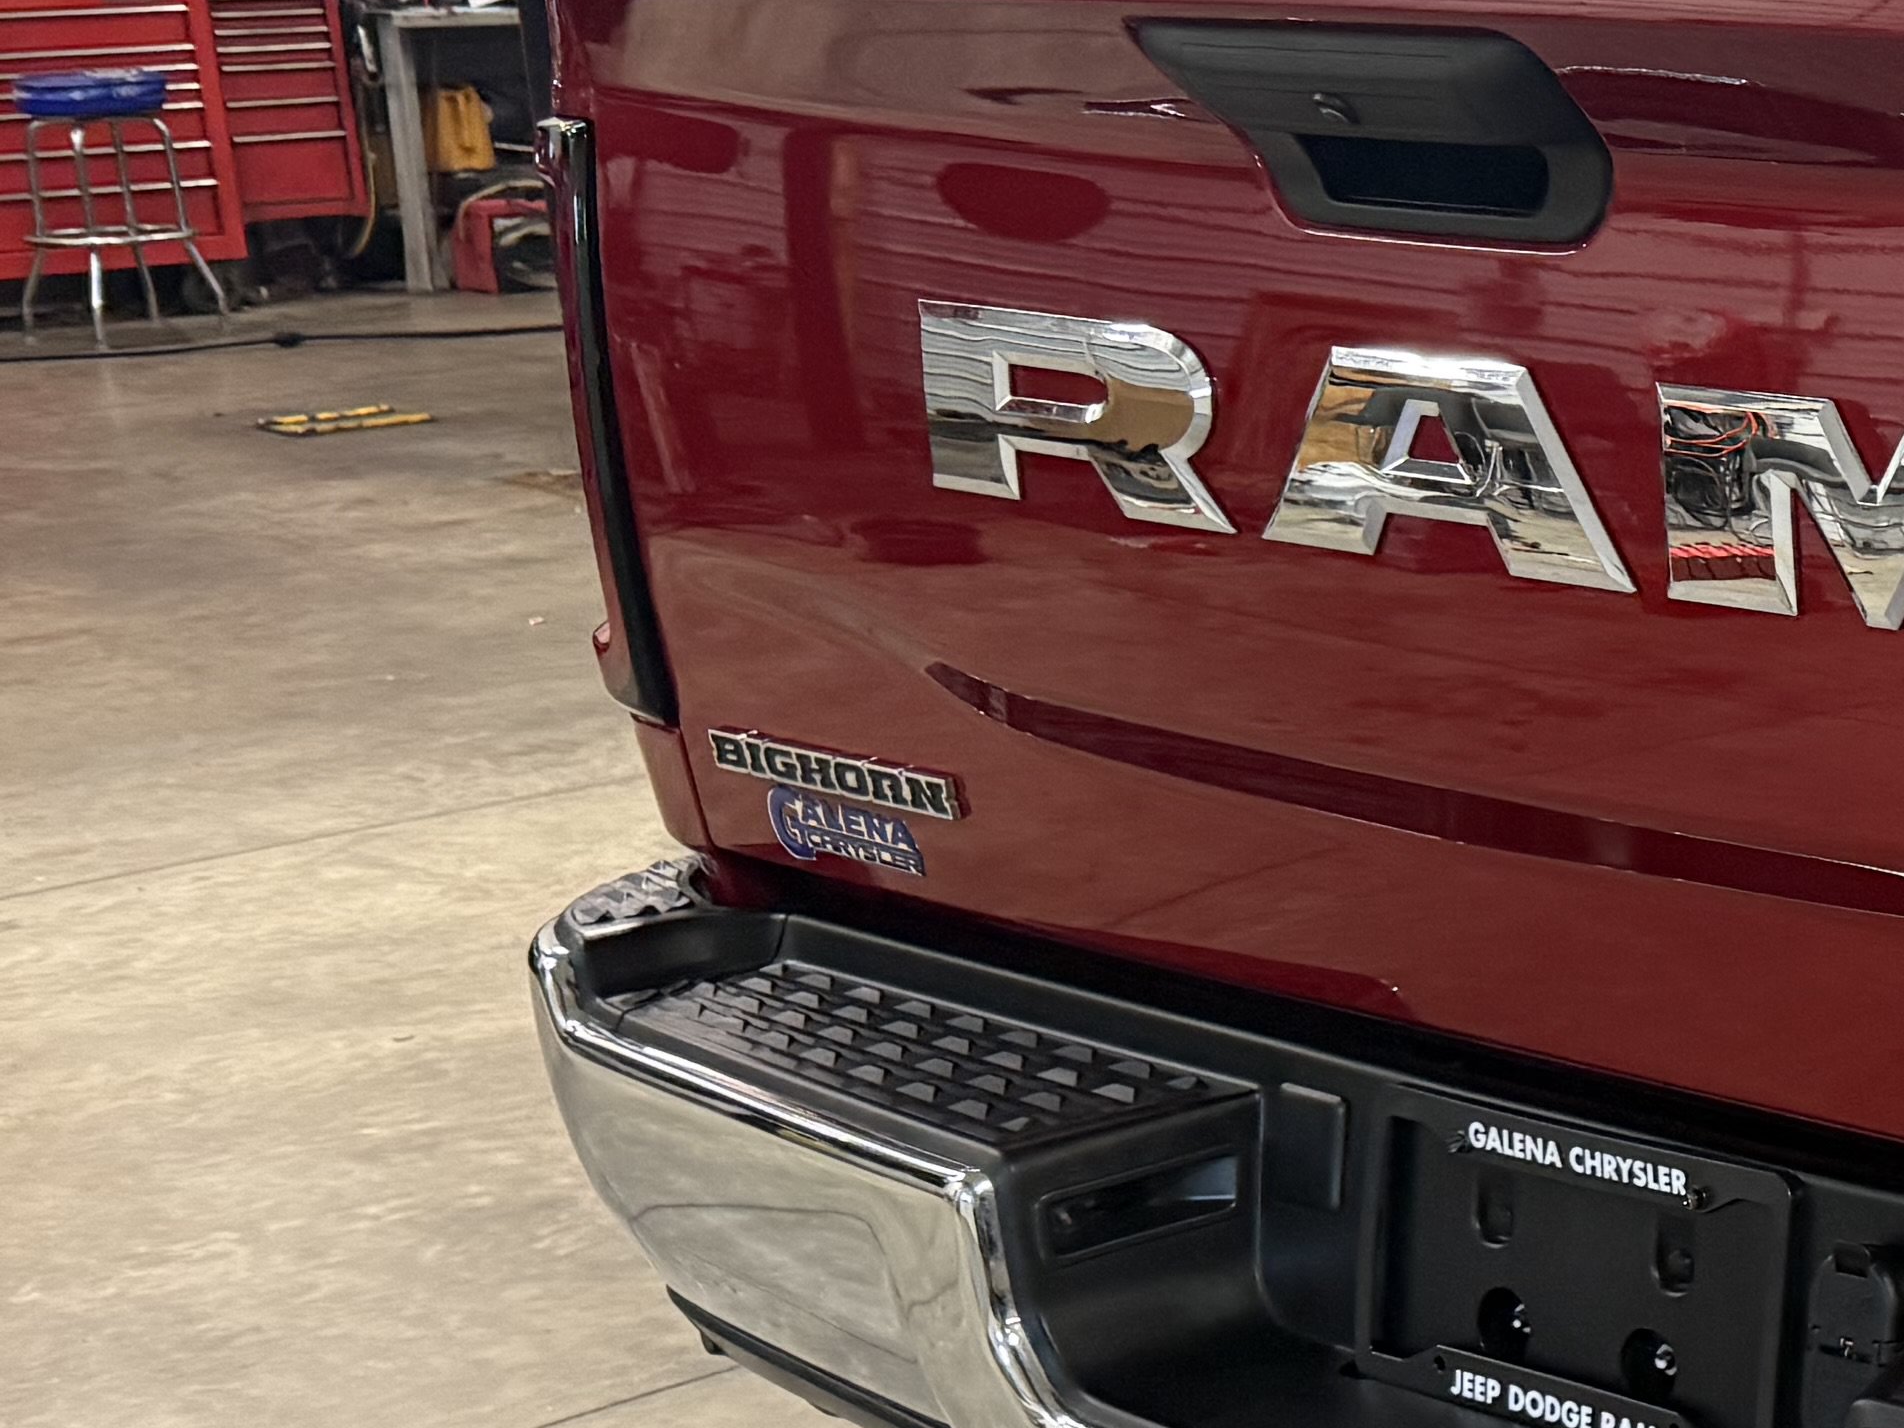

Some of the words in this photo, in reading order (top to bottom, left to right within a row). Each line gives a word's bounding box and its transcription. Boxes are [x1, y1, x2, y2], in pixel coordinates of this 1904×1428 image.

[707, 728, 957, 821] BIGHORN
[767, 784, 918, 861] GALENA
[807, 828, 926, 876] CHRYSLER
[1467, 1121, 1564, 1169] GALENA
[1568, 1145, 1688, 1197] CHRYSLER
[1450, 1369, 1501, 1404] JEEP
